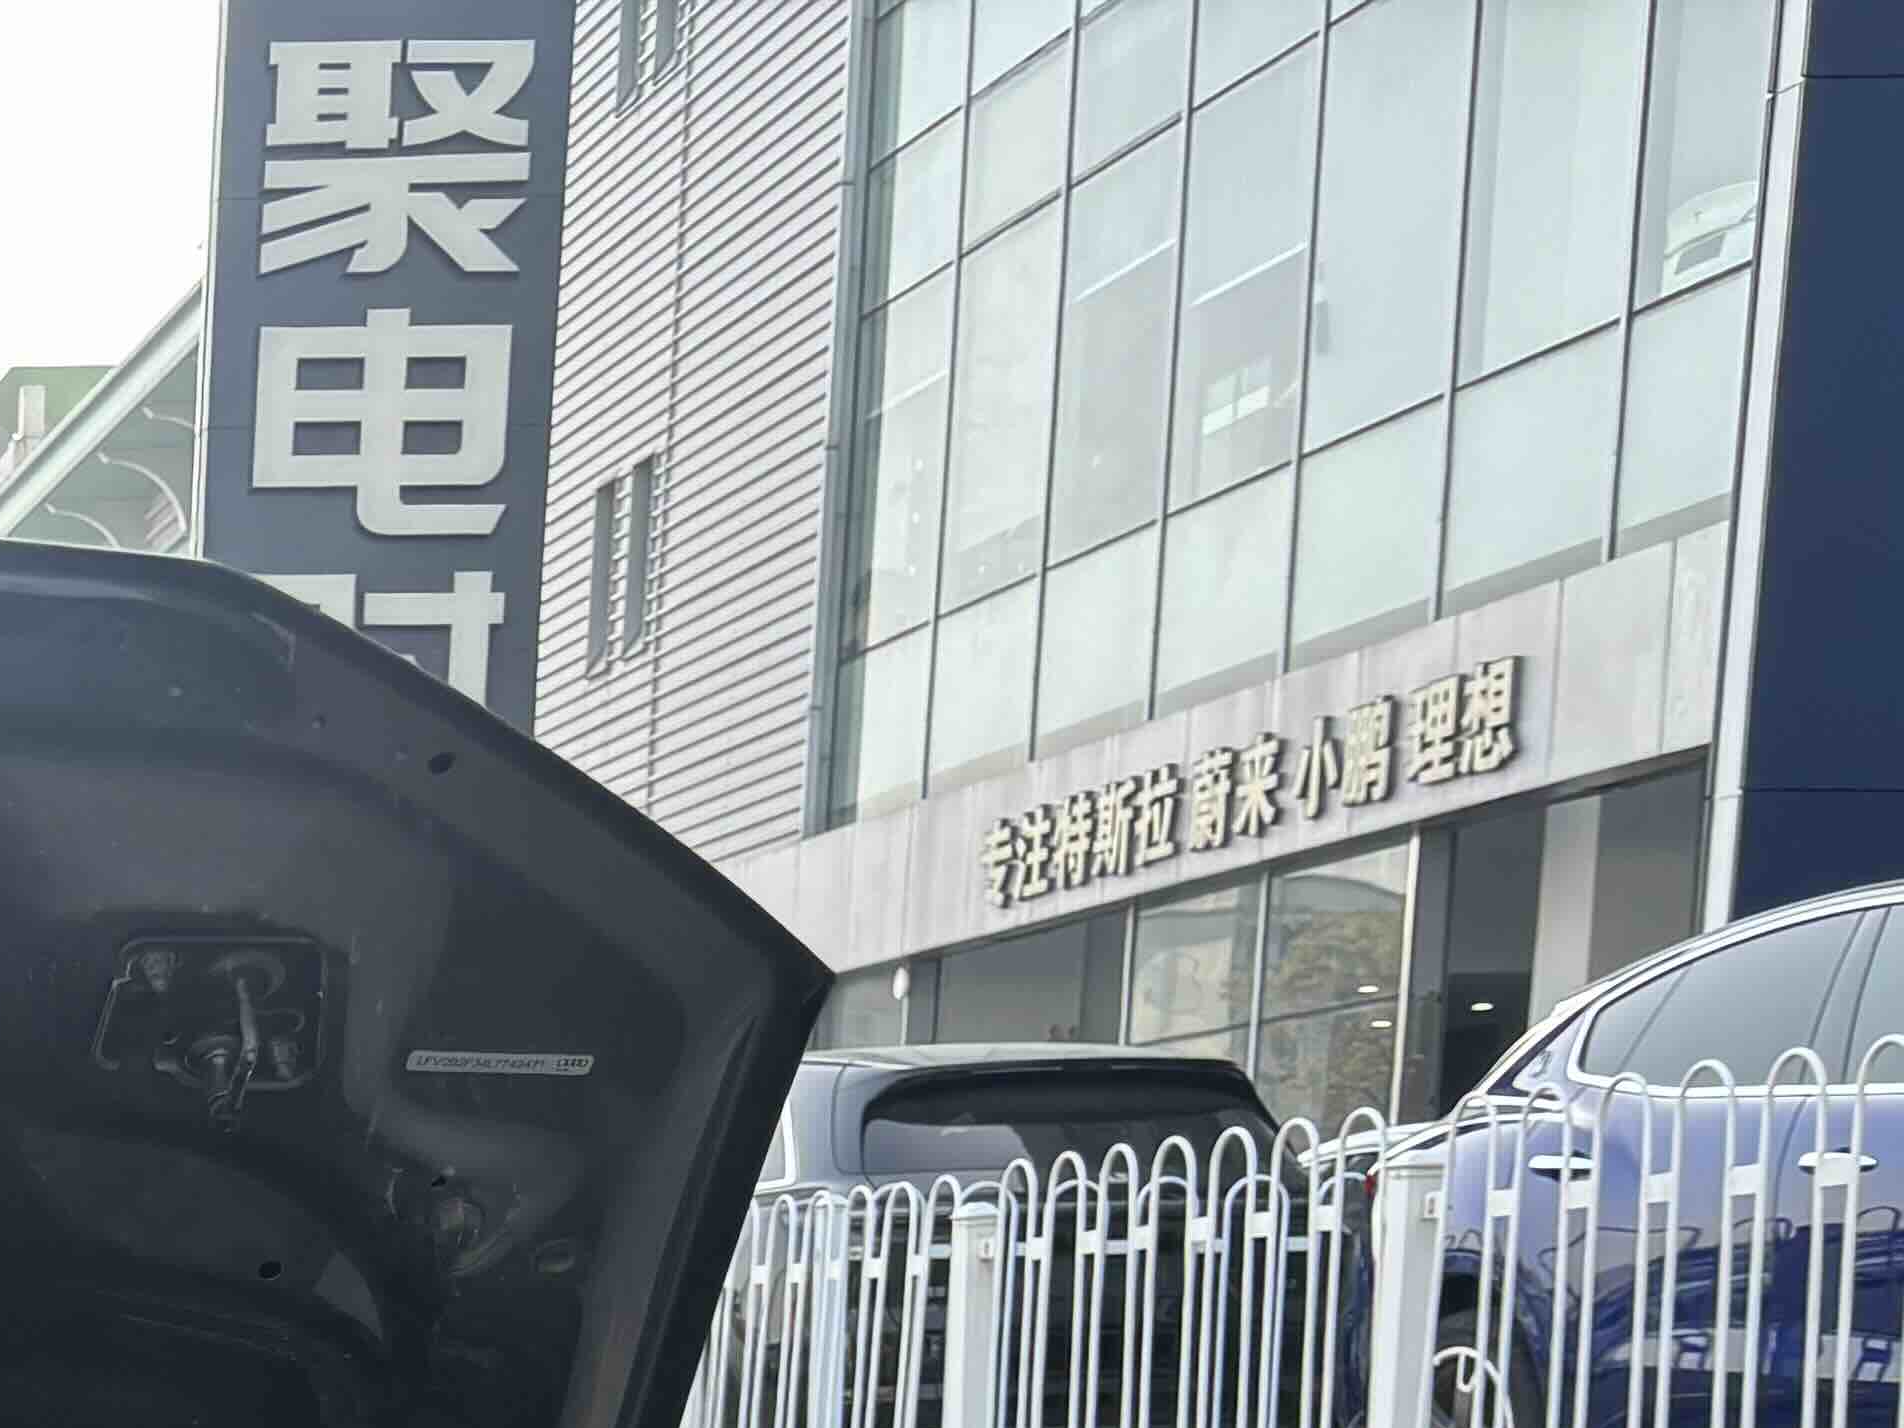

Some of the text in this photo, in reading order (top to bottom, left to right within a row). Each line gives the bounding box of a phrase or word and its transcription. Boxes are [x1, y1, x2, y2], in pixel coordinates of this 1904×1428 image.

[978, 655, 1522, 909] 专注特斯拉 蔚来 小鹏 理想
